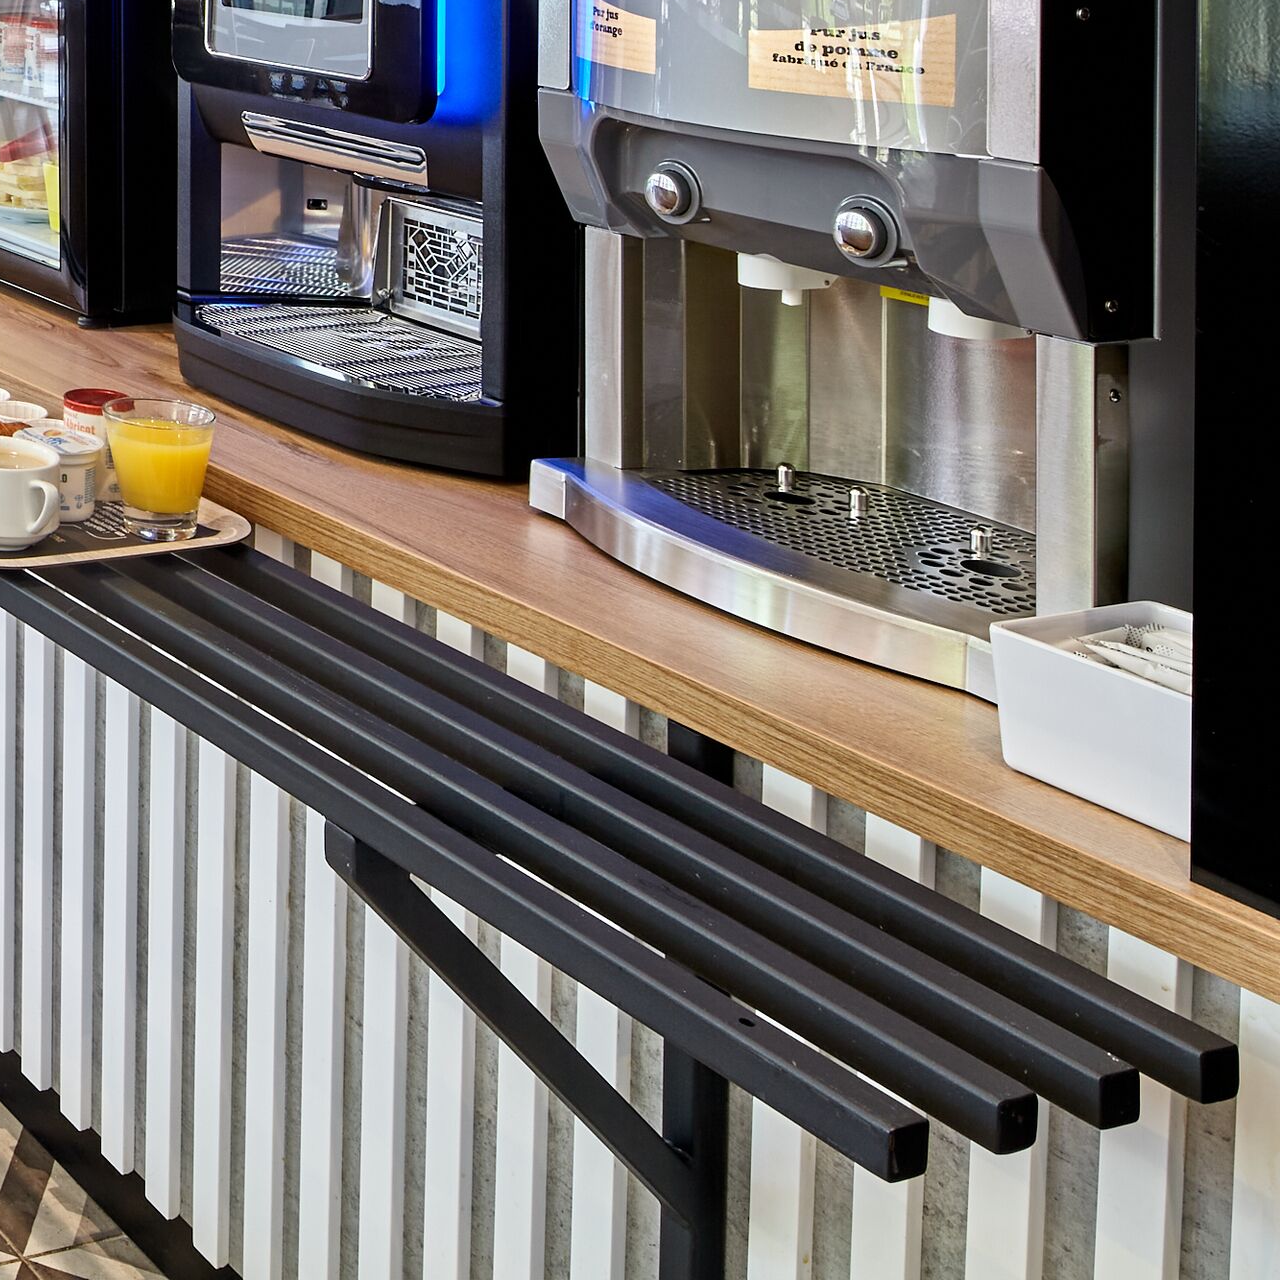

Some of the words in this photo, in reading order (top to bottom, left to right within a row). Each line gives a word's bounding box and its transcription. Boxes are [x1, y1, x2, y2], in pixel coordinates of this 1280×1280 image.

[593, 6, 605, 17] Pur
[606, 8, 619, 21] jus
[848, 27, 881, 43] jus
[794, 41, 816, 53] de
